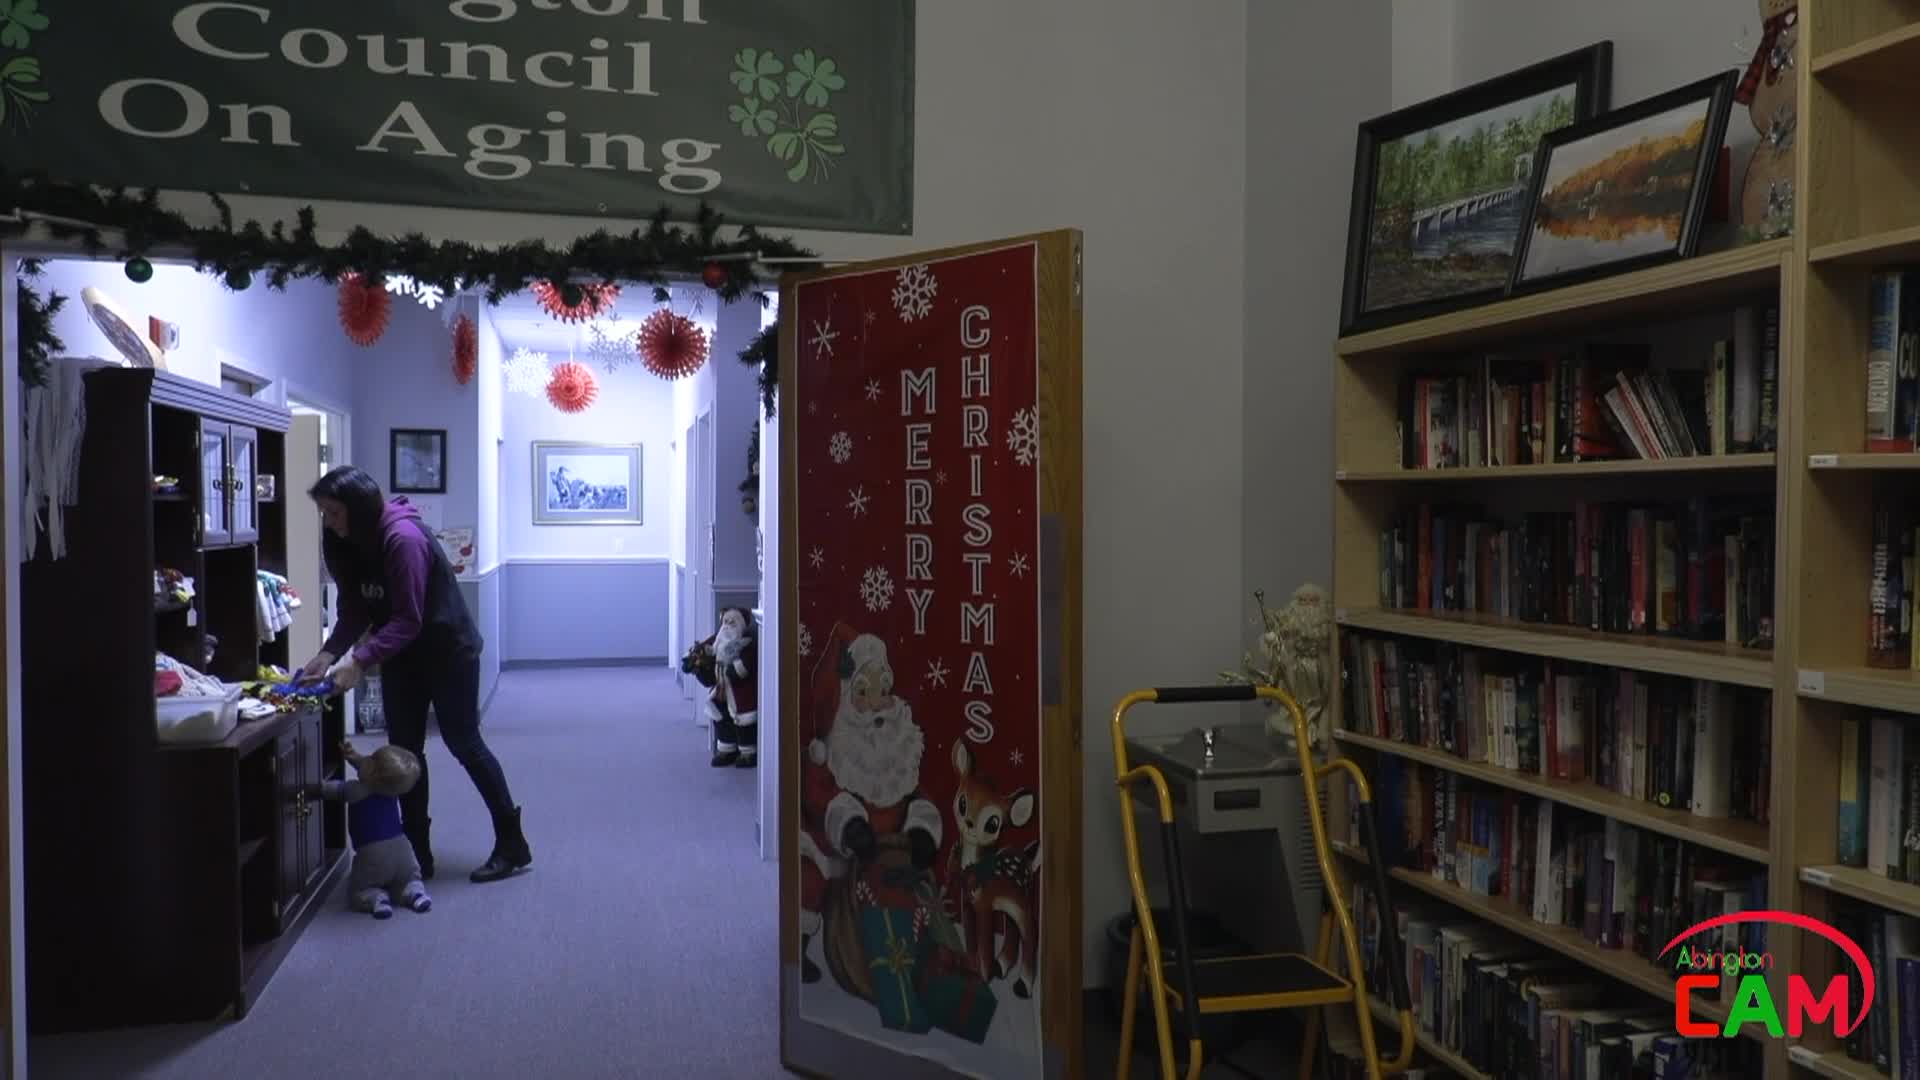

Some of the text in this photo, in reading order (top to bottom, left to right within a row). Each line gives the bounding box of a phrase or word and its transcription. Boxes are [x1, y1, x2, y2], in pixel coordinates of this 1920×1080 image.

[97, 78, 722, 194] On Aging
[172, 1, 660, 96] Council
[901, 367, 936, 635] MERRY
[959, 305, 994, 744] CHRISTMAS
